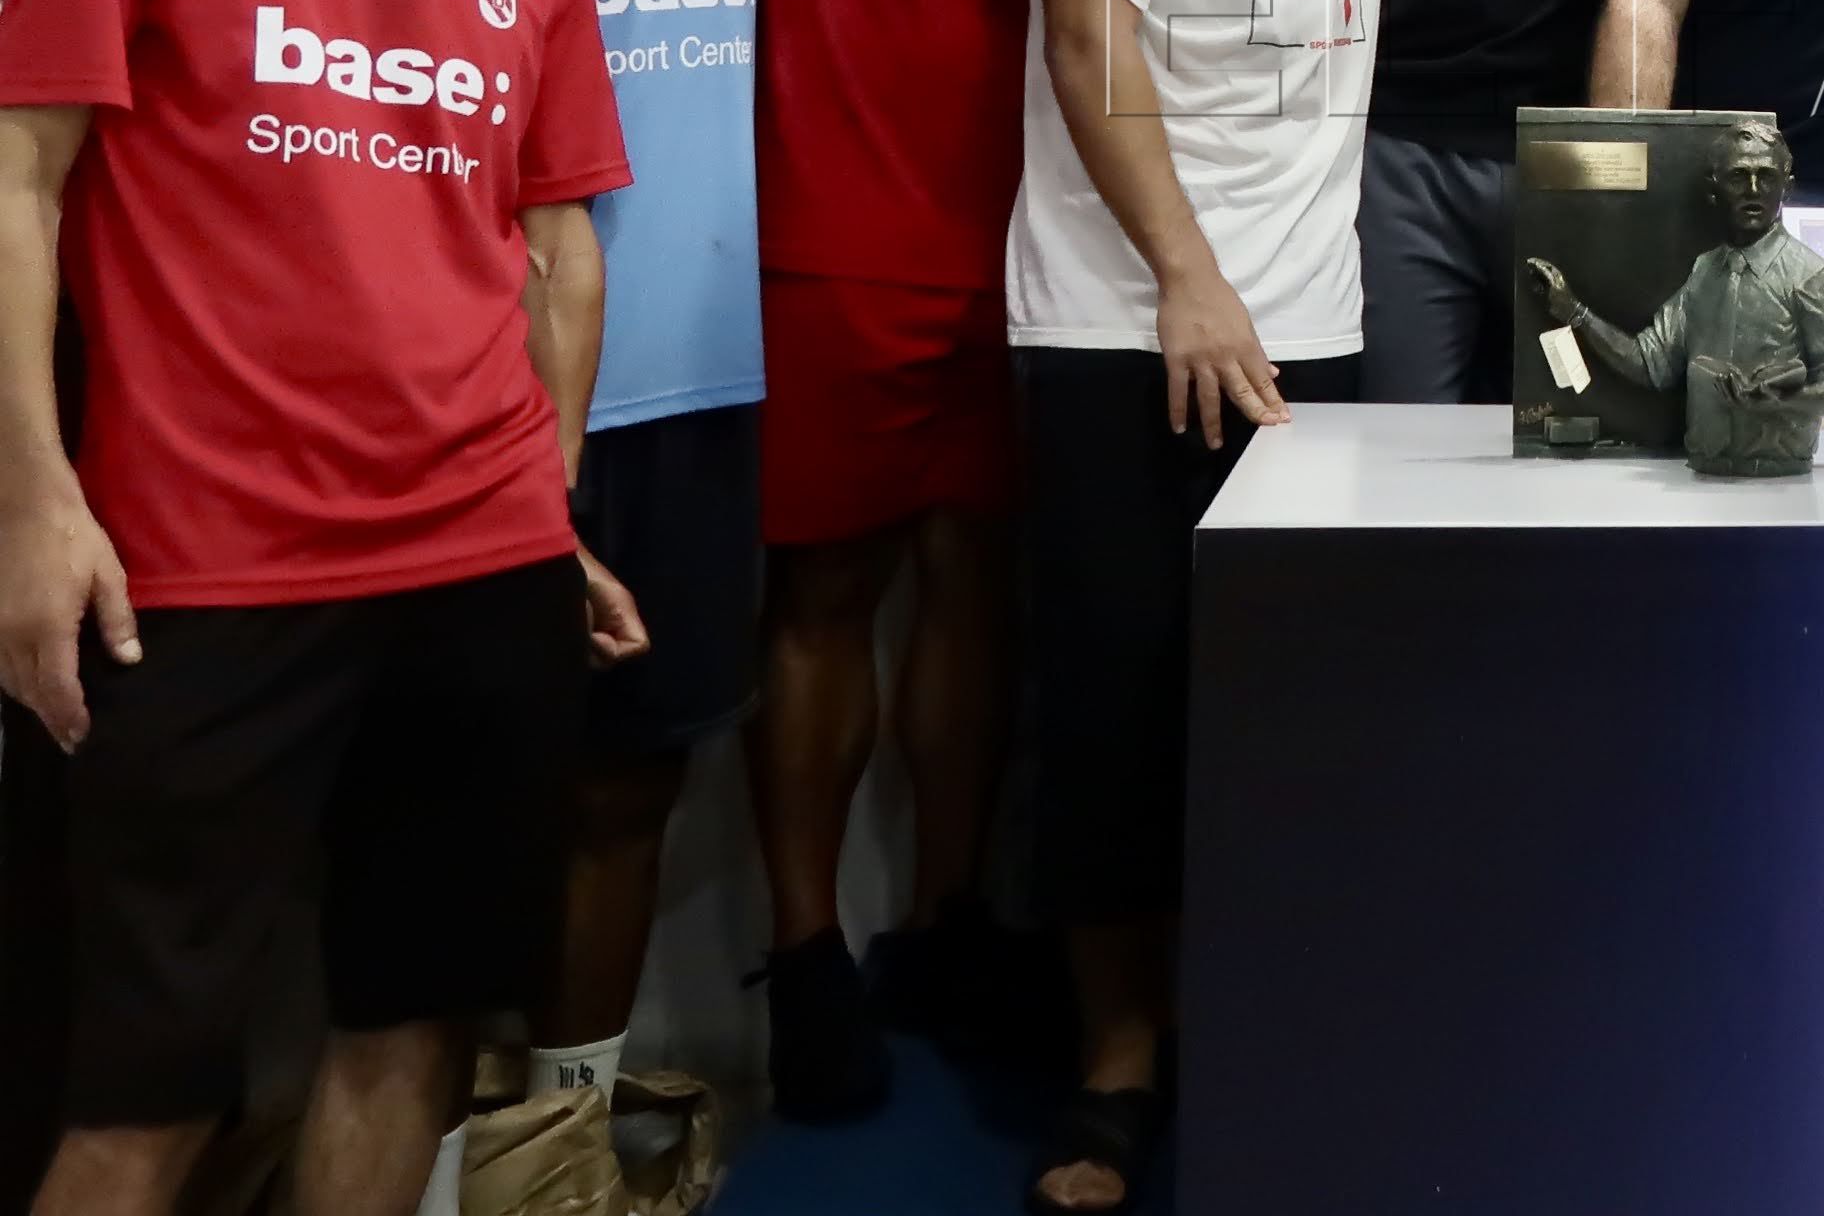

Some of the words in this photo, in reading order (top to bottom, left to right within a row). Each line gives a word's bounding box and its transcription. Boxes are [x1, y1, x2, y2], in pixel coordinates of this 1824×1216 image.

[605, 40, 670, 79] port
[679, 35, 753, 68] Cente
[248, 113, 361, 164] Sport
